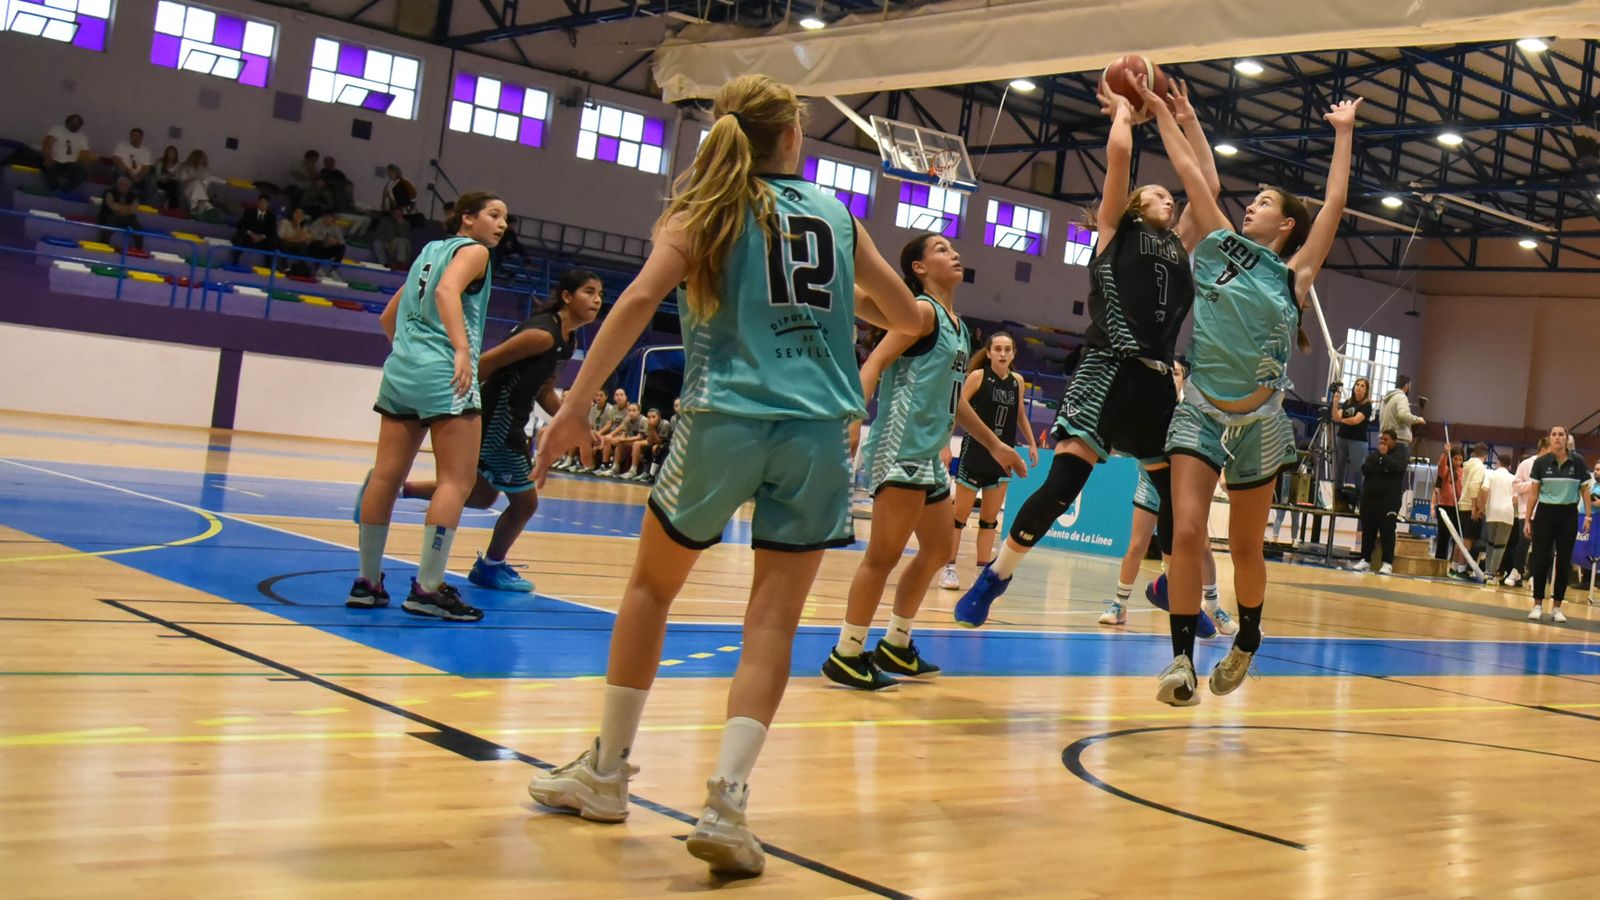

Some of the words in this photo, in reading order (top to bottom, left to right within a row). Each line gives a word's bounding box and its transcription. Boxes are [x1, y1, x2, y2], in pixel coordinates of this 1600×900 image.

[765, 212, 836, 311] 12
[1070, 530, 1080, 541] de
[1081, 532, 1091, 543] La
[1091, 533, 1113, 546] Línea
